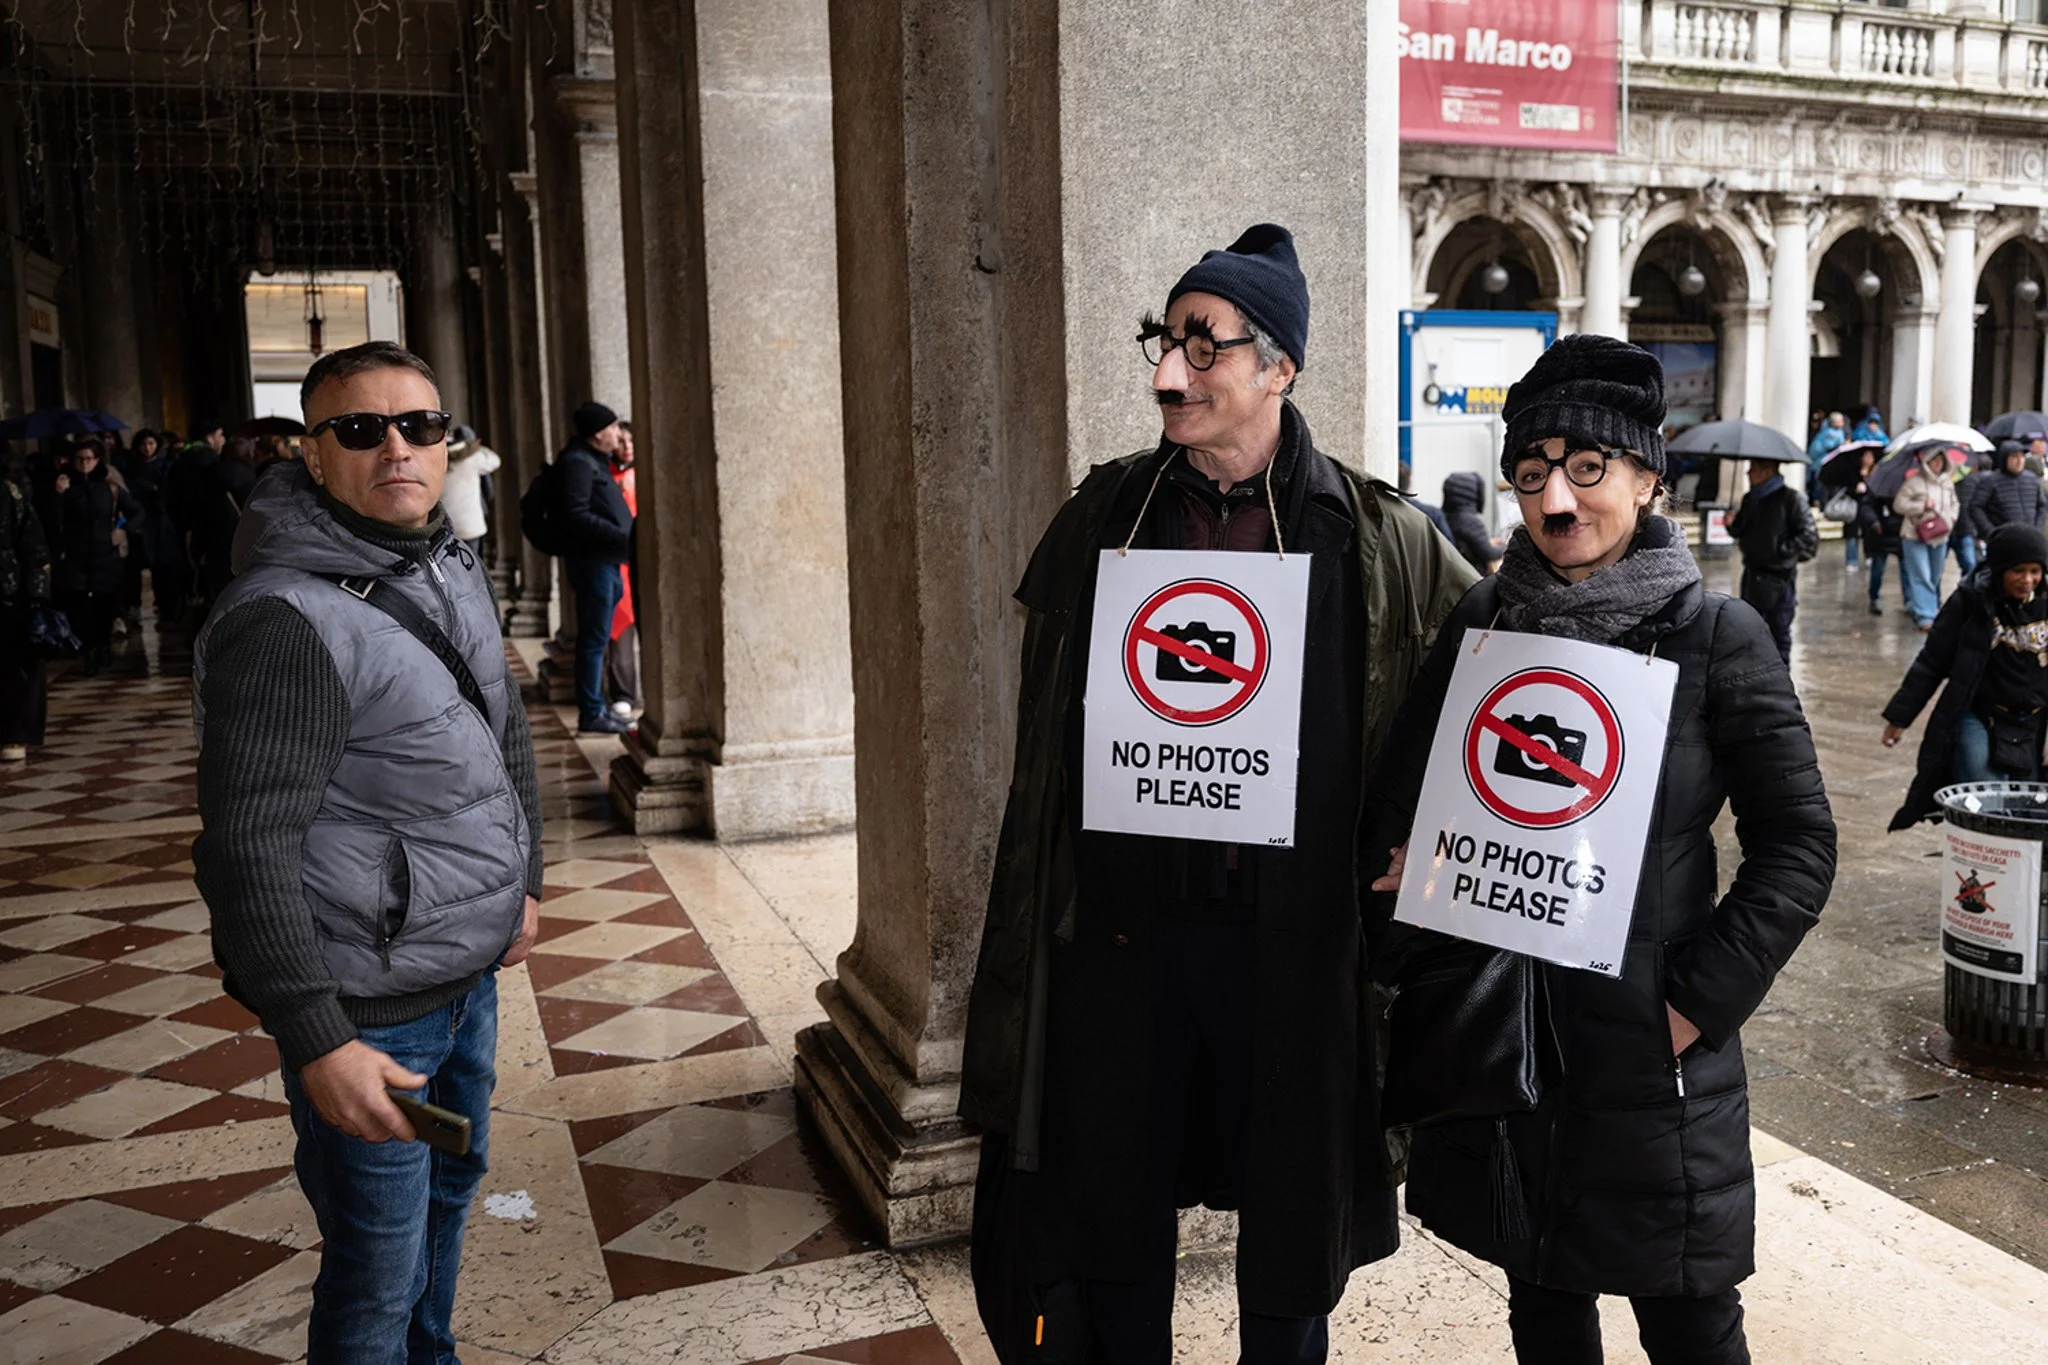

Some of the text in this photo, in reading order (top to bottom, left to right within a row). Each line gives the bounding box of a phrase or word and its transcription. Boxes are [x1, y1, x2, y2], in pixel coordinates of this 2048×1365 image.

[1398, 22, 1572, 71] San Marco
[417, 620, 477, 697] GUESS
[1112, 741, 1270, 776] NO PHOTOS
[1136, 778, 1241, 810] PLEASE
[1435, 830, 1606, 894] NO PHOTOS
[1453, 873, 1570, 926] PLEASE
